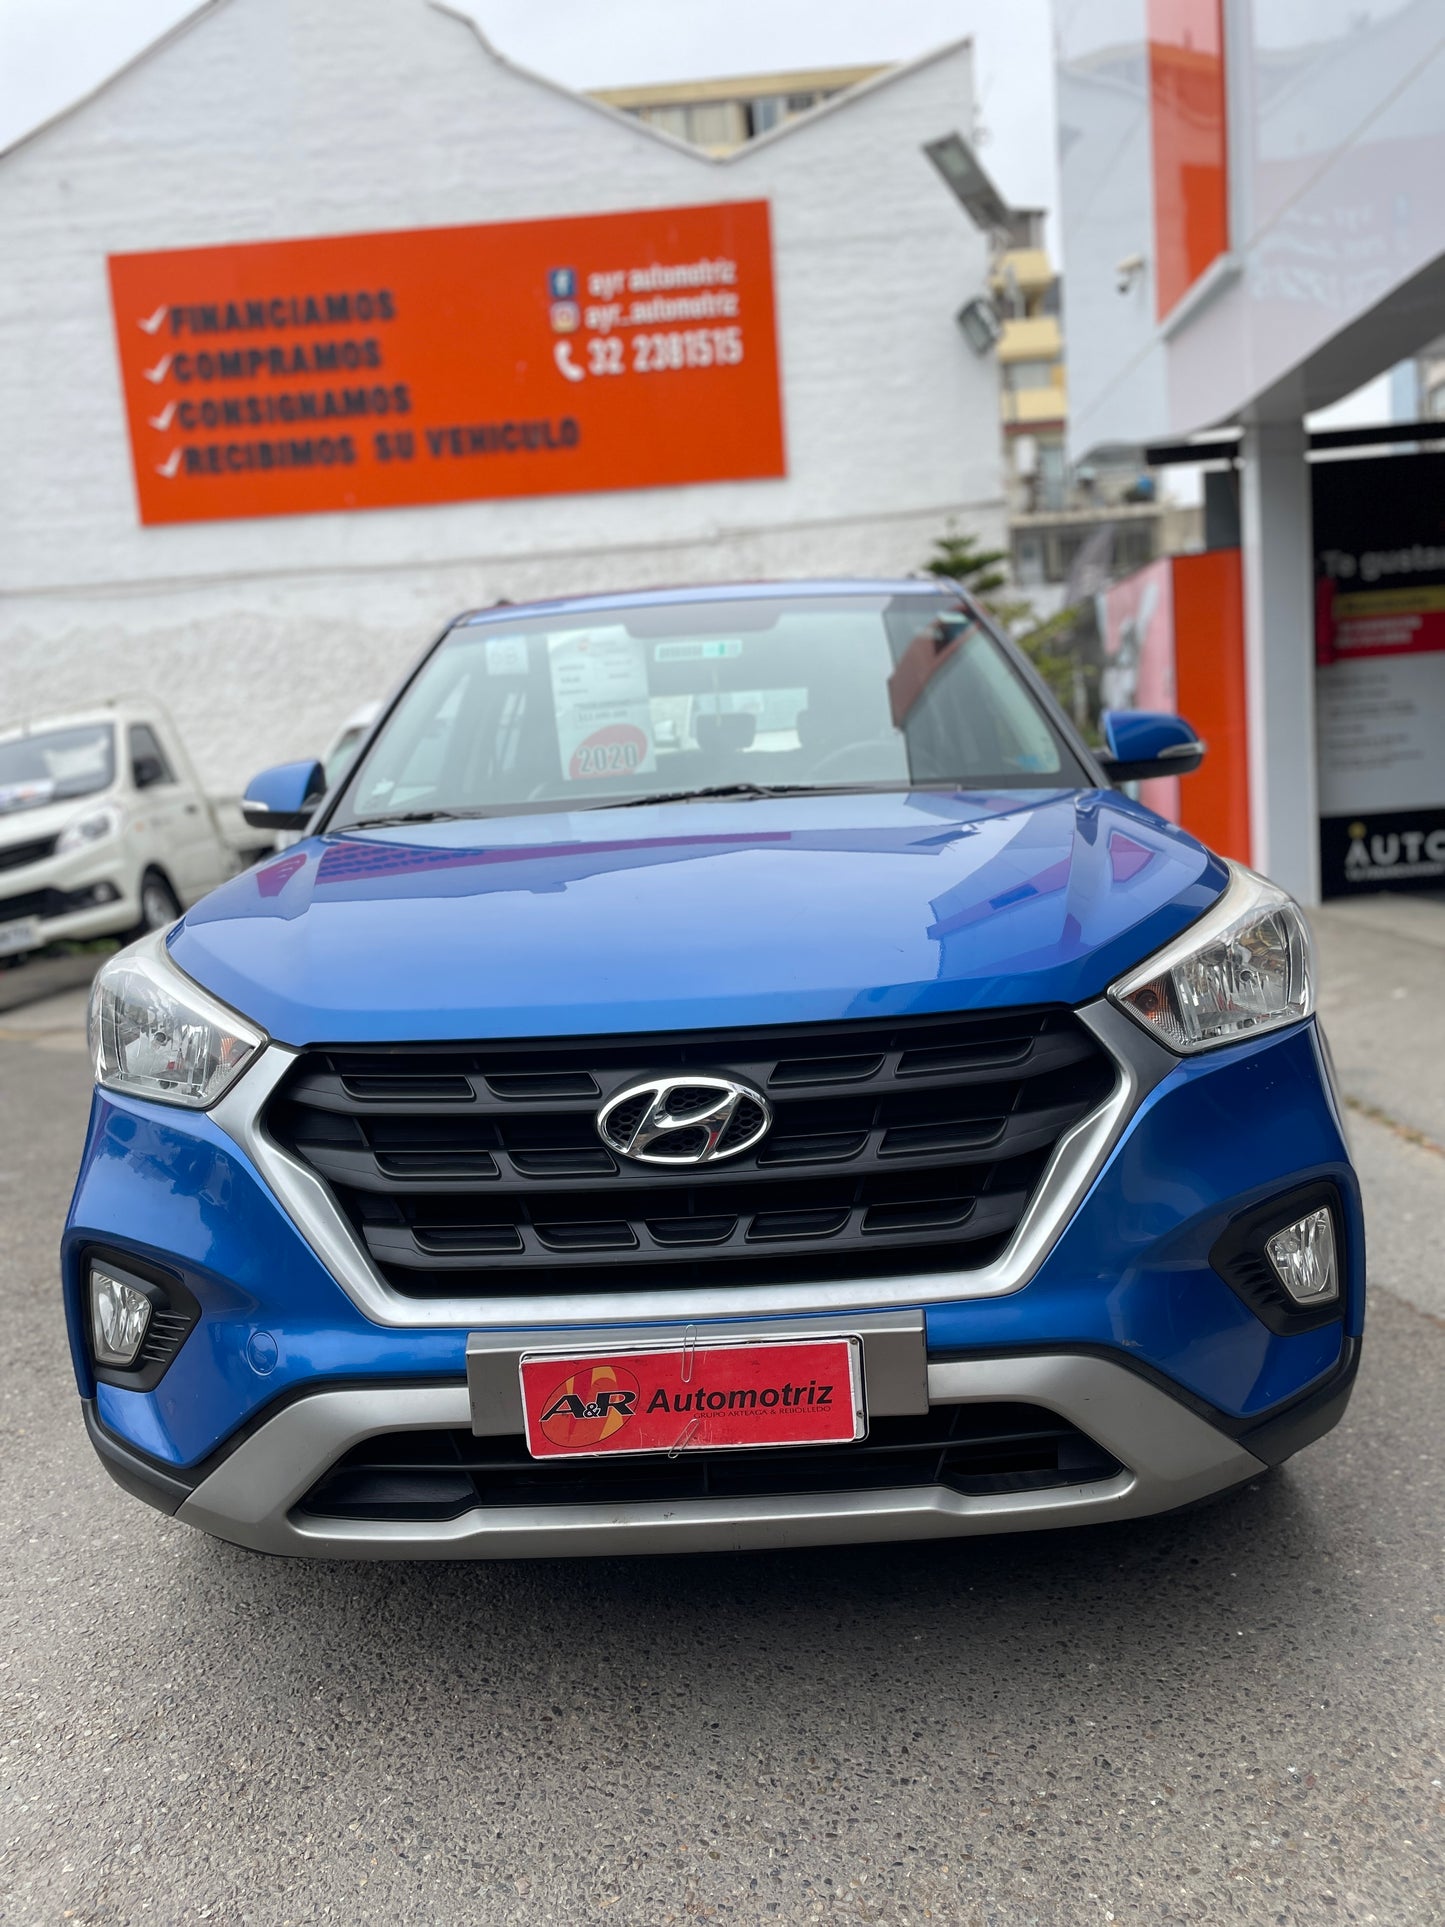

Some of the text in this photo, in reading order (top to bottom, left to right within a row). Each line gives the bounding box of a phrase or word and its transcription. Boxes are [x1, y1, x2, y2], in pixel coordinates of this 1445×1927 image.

[170, 290, 394, 337] FINANCIAMOS
[173, 338, 381, 384] COMPRAMOS
[587, 326, 744, 375] 32 2381515
[178, 384, 411, 431] CONSIGNAMOS
[185, 417, 579, 476] RECIBIMOS SU VEHICULO
[579, 743, 638, 773] 2020
[538, 1380, 834, 1422] A&R Automotriz
[693, 1411, 726, 1420] GRUPO
[728, 1410, 768, 1418] ARTEAGA
[779, 1405, 832, 1415] REBOLLEDO
